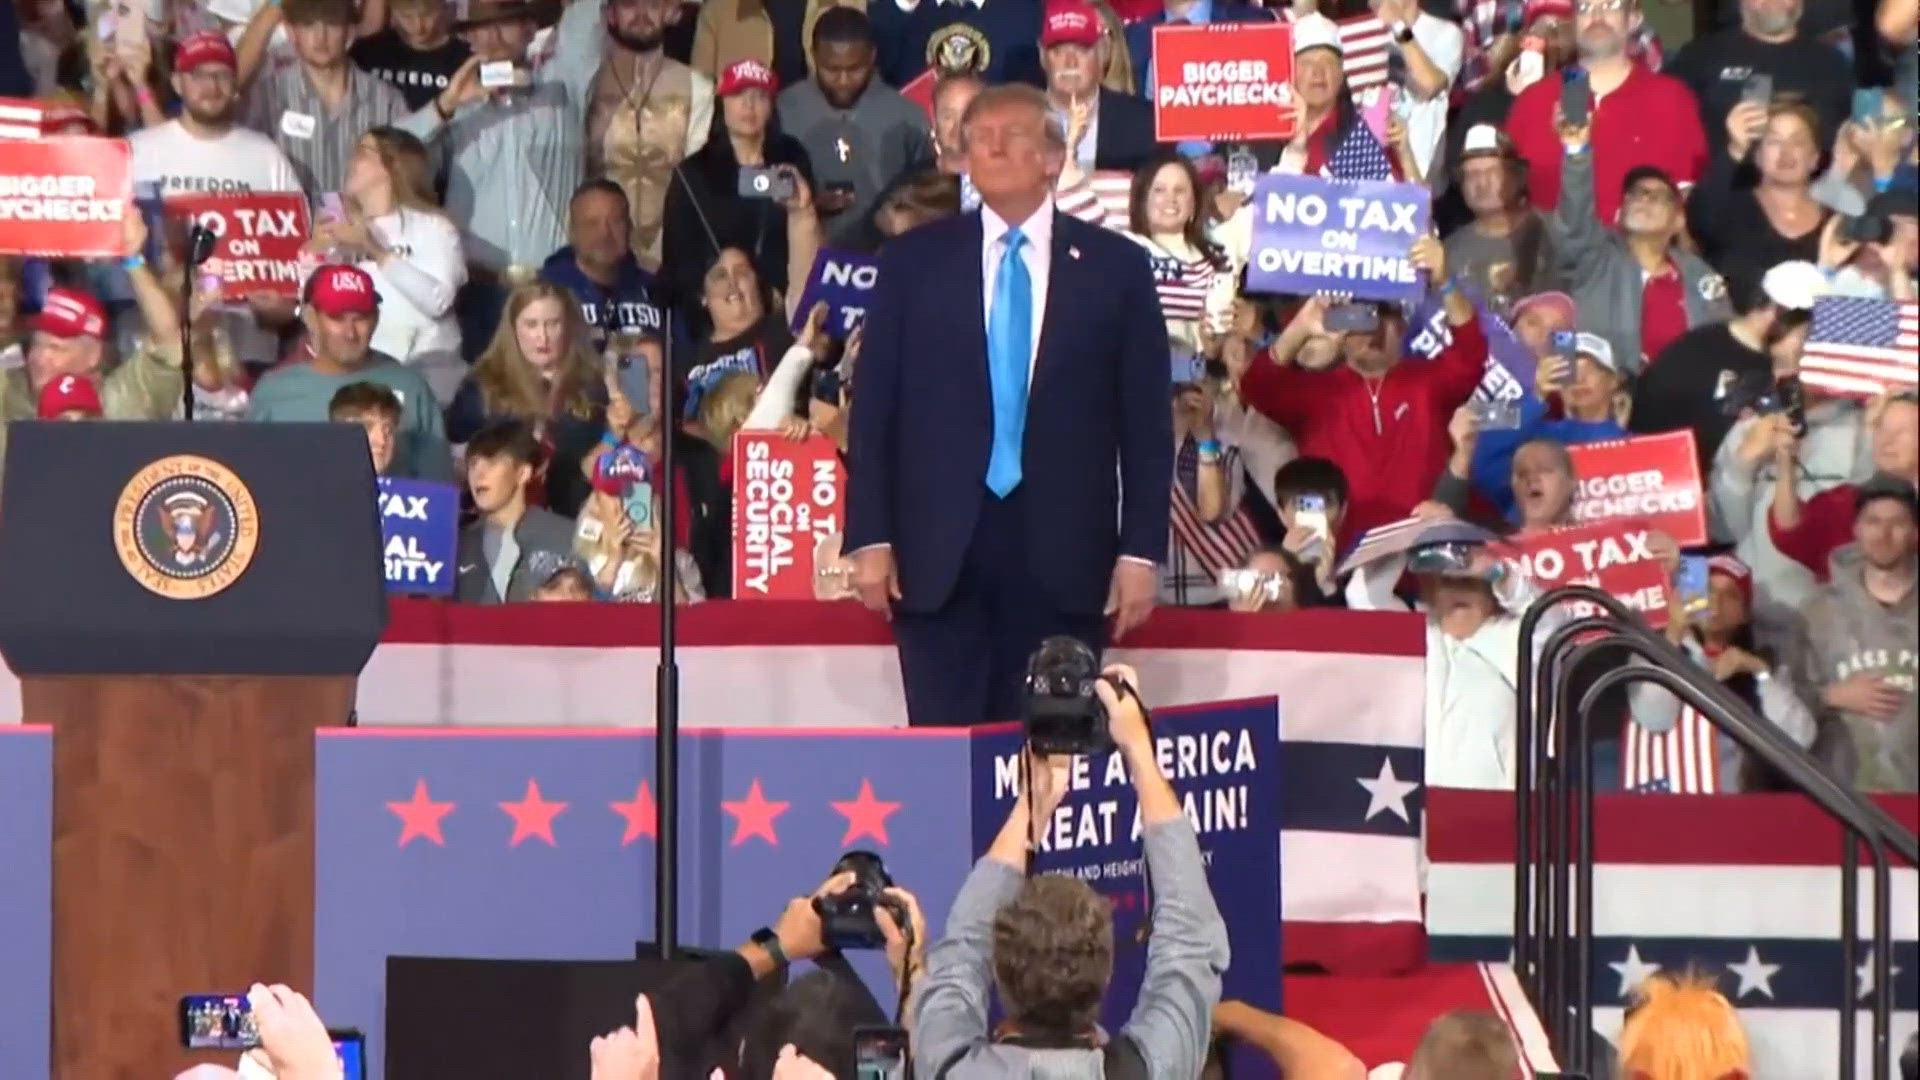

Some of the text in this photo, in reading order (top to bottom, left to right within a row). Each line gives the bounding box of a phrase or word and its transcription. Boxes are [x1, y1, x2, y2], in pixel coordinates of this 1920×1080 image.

[1183, 60, 1268, 83] BIGGER
[1160, 81, 1292, 107] PAYCHECKS
[233, 209, 300, 238] TAX
[1266, 192, 1418, 234] NO TAX
[228, 239, 261, 257] ON
[1321, 229, 1358, 251] ON
[821, 260, 878, 290] NO
[1257, 248, 1417, 283] OVERTIME
[332, 271, 365, 293] USA
[813, 459, 836, 506] NO
[1578, 469, 1664, 499] IGGER
[744, 441, 769, 594] SECURITY
[769, 459, 793, 576] SOCIAL
[796, 503, 810, 531] ON
[1572, 530, 1654, 571] TAX
[994, 728, 1257, 800] ME AERICA
[1033, 784, 1249, 853] REAT AAIN!
[1103, 858, 1145, 878] HEIGHT
